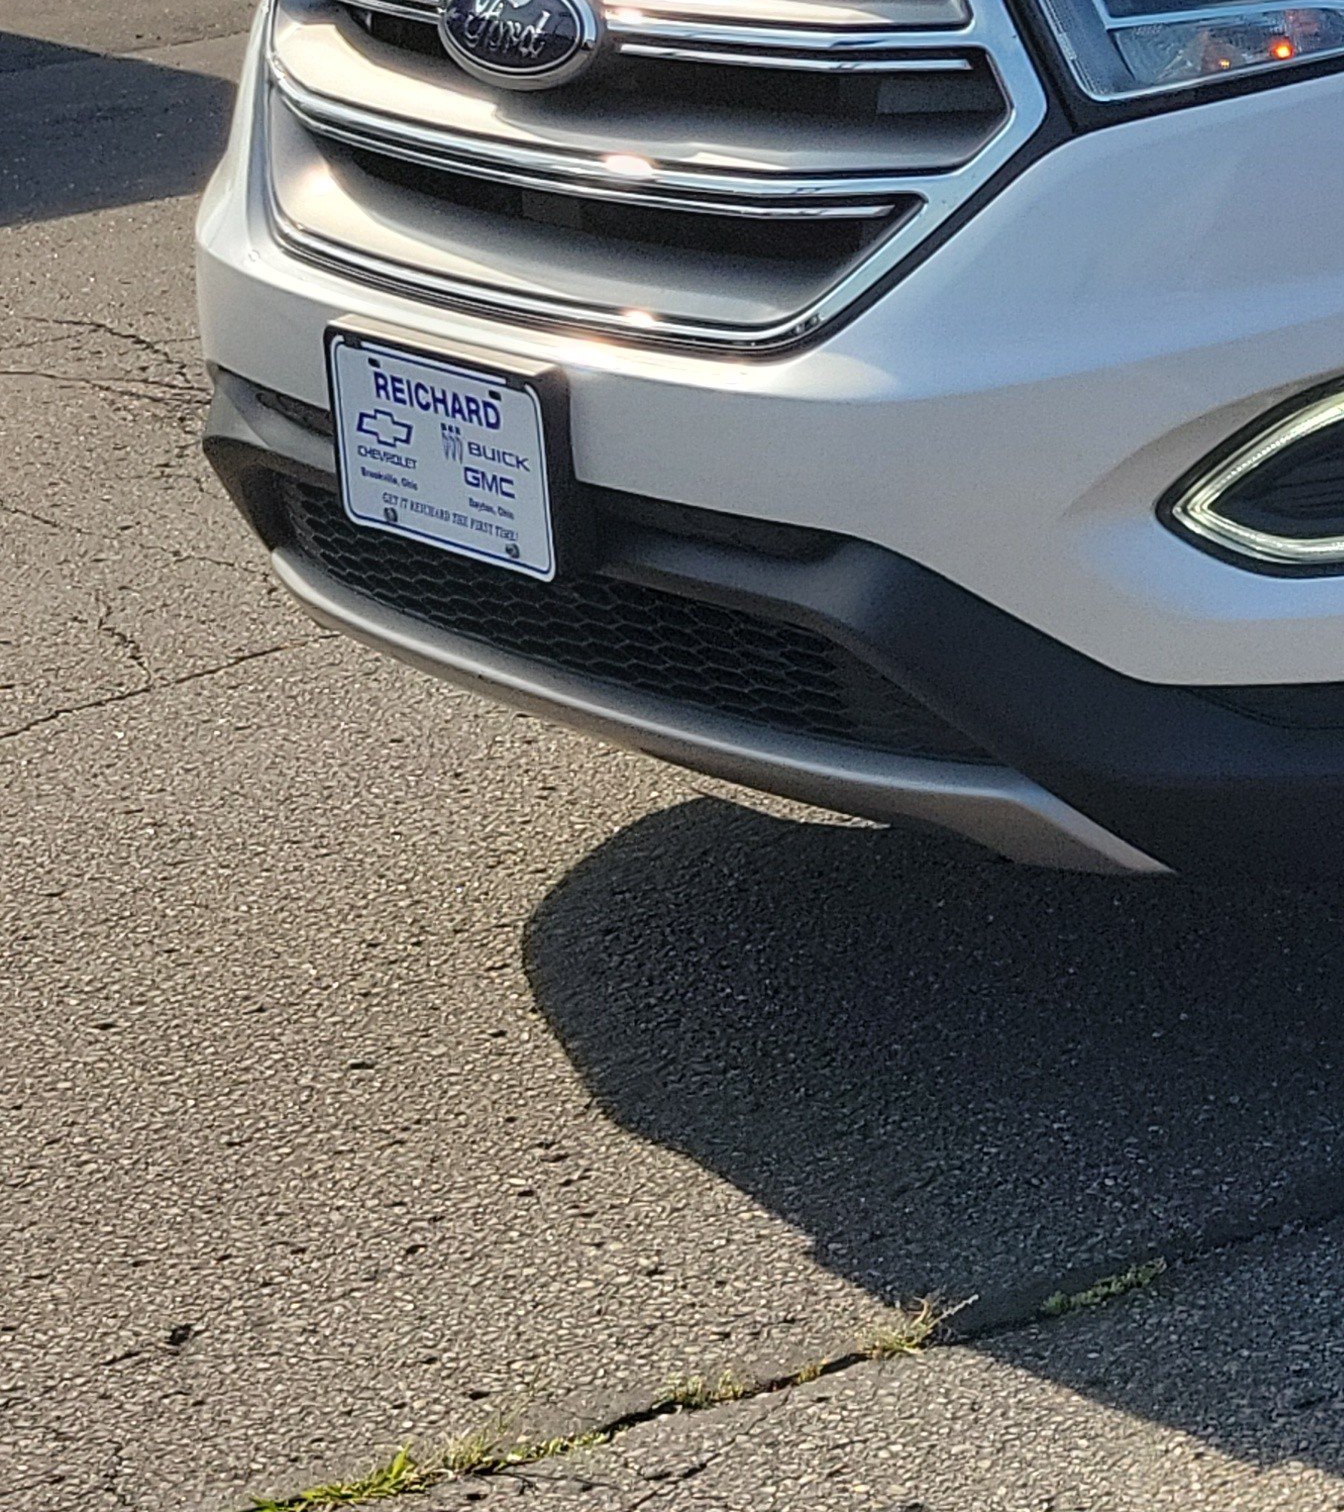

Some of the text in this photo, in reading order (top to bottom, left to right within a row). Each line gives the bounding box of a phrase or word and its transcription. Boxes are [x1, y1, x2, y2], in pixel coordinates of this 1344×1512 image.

[373, 371, 501, 430] REICHARD
[357, 444, 418, 470] CHEVROLET
[467, 441, 531, 472] BUICK
[464, 466, 516, 499] GMC
